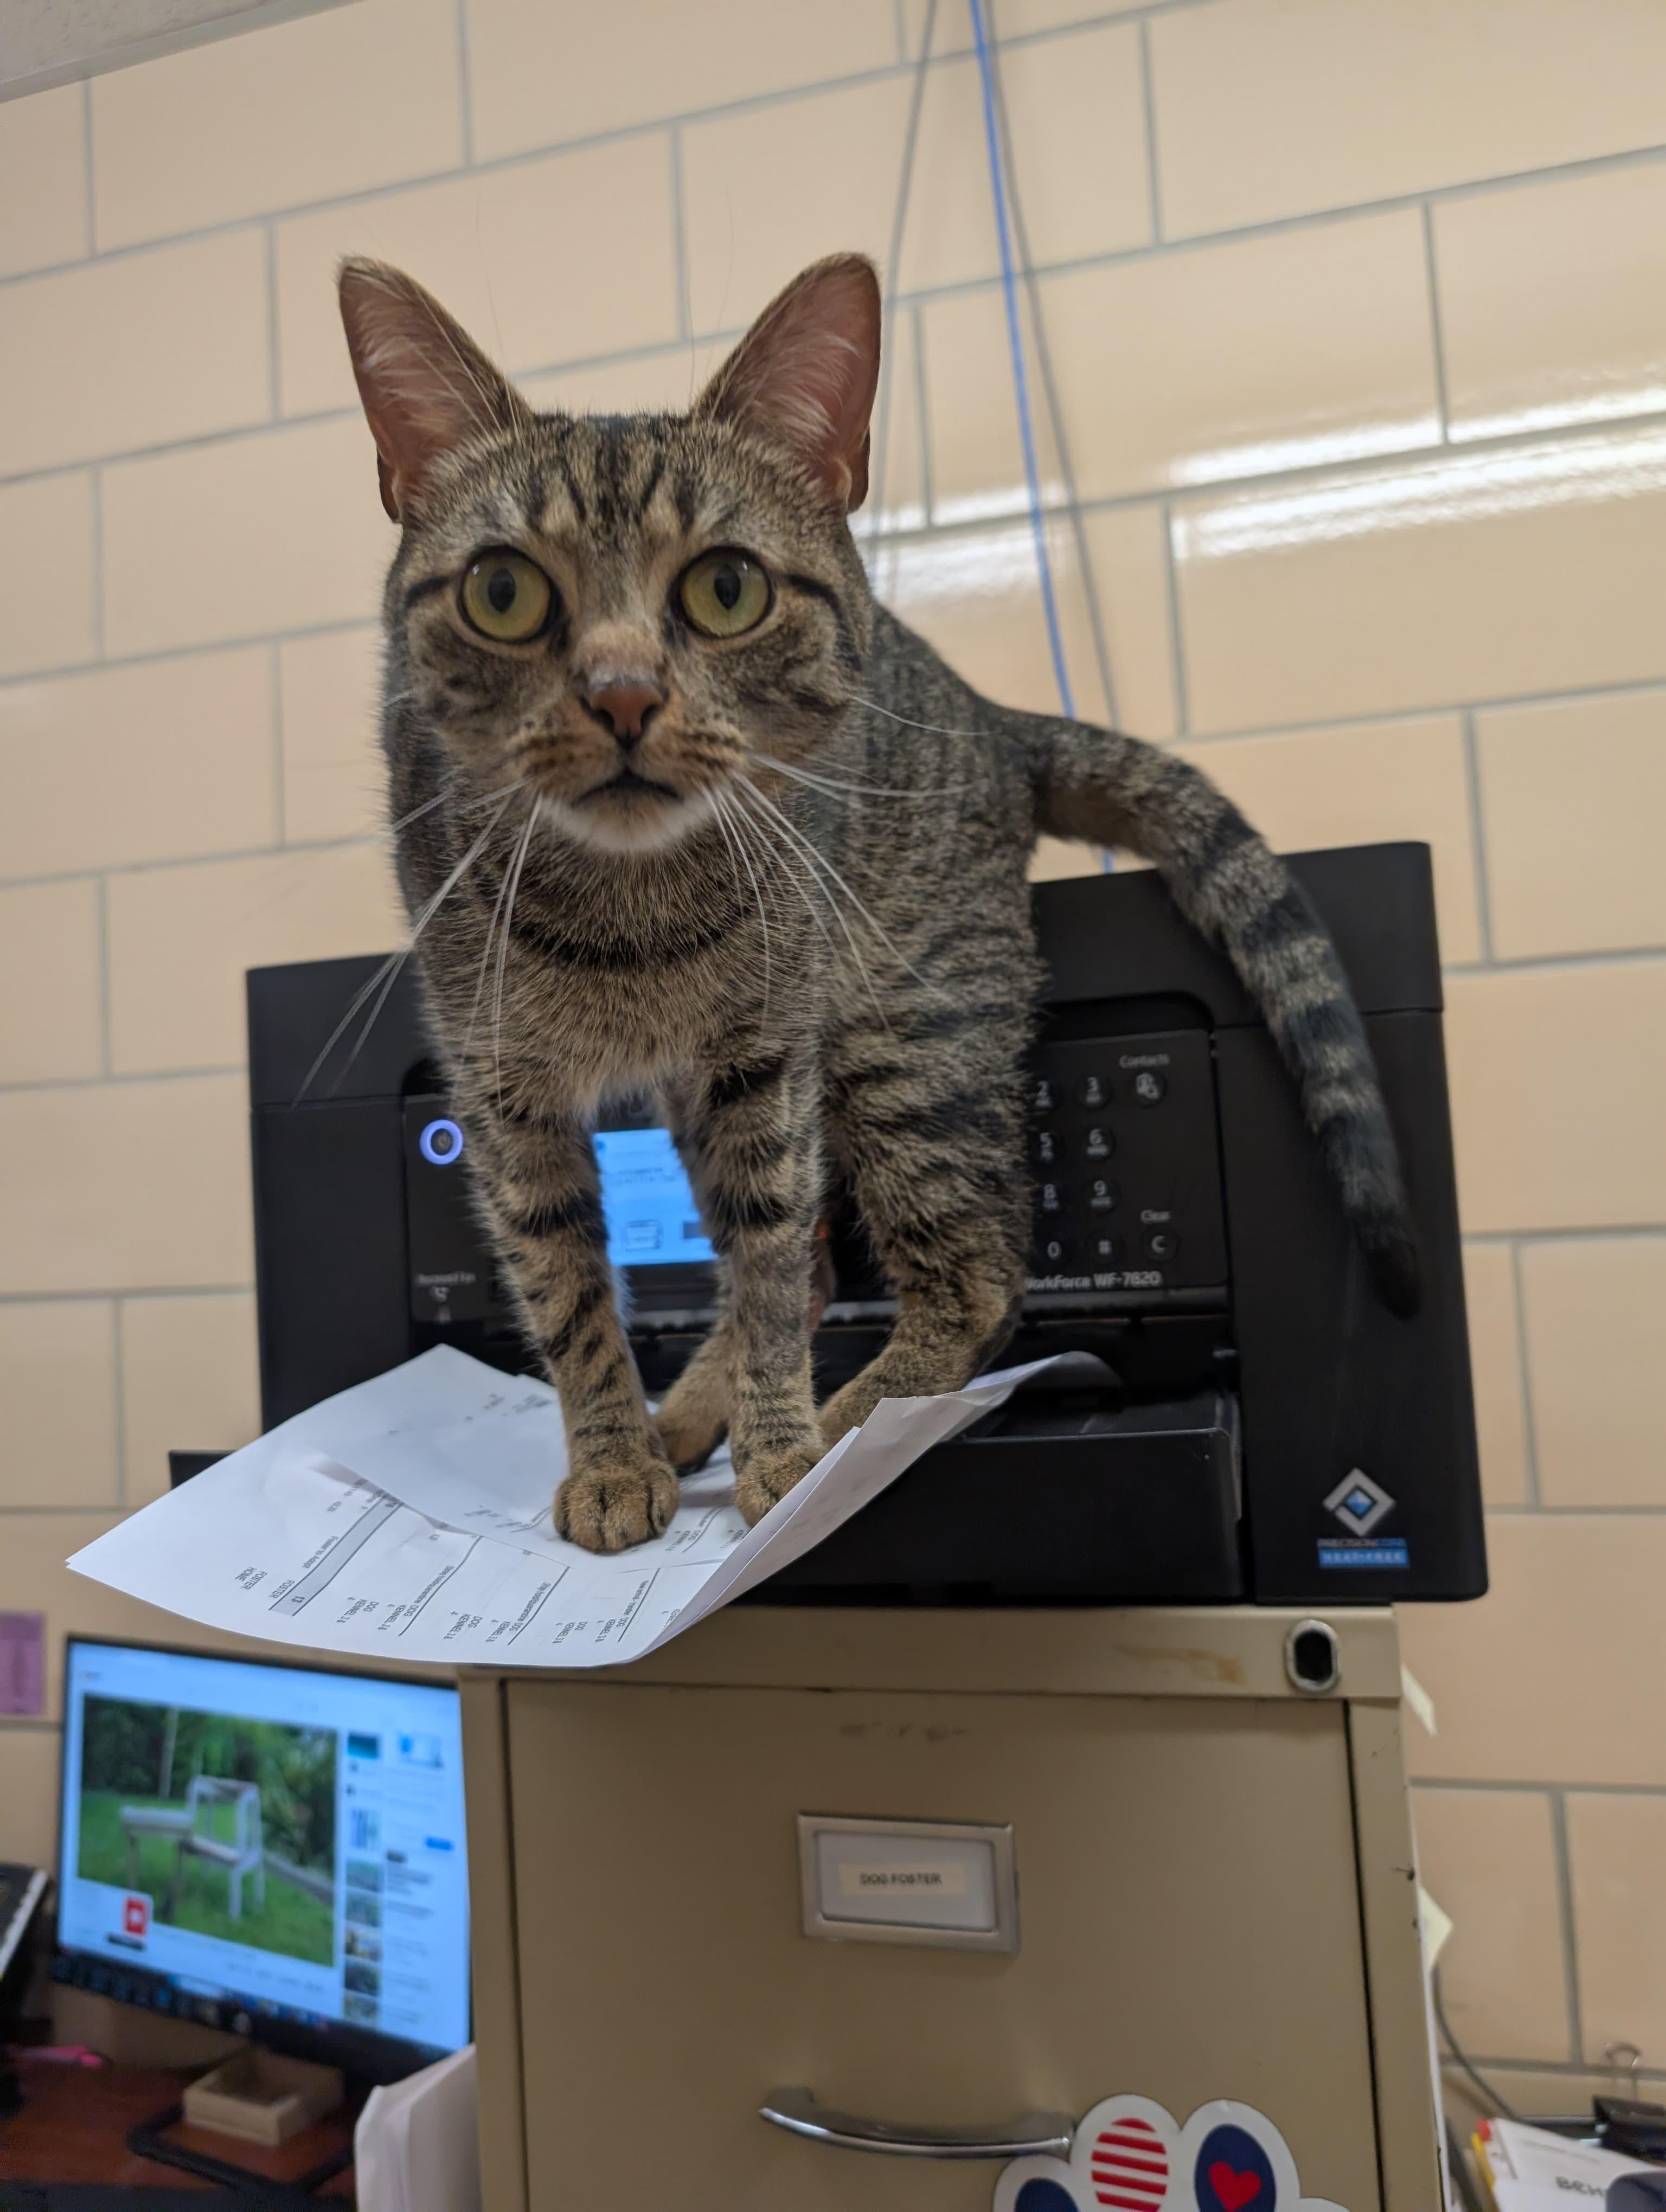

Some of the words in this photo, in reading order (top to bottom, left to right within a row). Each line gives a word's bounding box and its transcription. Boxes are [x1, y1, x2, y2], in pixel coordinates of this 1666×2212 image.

[1036, 1081, 1049, 1097] 2
[1086, 1076, 1099, 1093] 3
[1039, 1131, 1053, 1148] 5
[1088, 1128, 1103, 1144] 6
[1043, 1183, 1058, 1199] 8
[1093, 1180, 1108, 1197] 9
[1047, 1240, 1062, 1260] 0
[1151, 1235, 1167, 1254] C
[235, 1566, 257, 1581] HOME
[241, 1570, 268, 1590] FOSTER
[268, 1579, 296, 1599] FOSTER
[291, 1596, 305, 1604] 13
[344, 1599, 367, 1616] KENNEL
[363, 1601, 380, 1612] DOG
[384, 1604, 407, 1623] KENNEL
[403, 1604, 419, 1617] DOG
[449, 1613, 471, 1633] KENNEL
[468, 1615, 483, 1628] DOG
[491, 1621, 511, 1636] KENNEL
[557, 1622, 576, 1637] KENNEL
[574, 1621, 588, 1631] DOG
[599, 1618, 617, 1636] KENNEL
[860, 1872, 888, 1886] DOG
[891, 1872, 943, 1886] FOSTER
